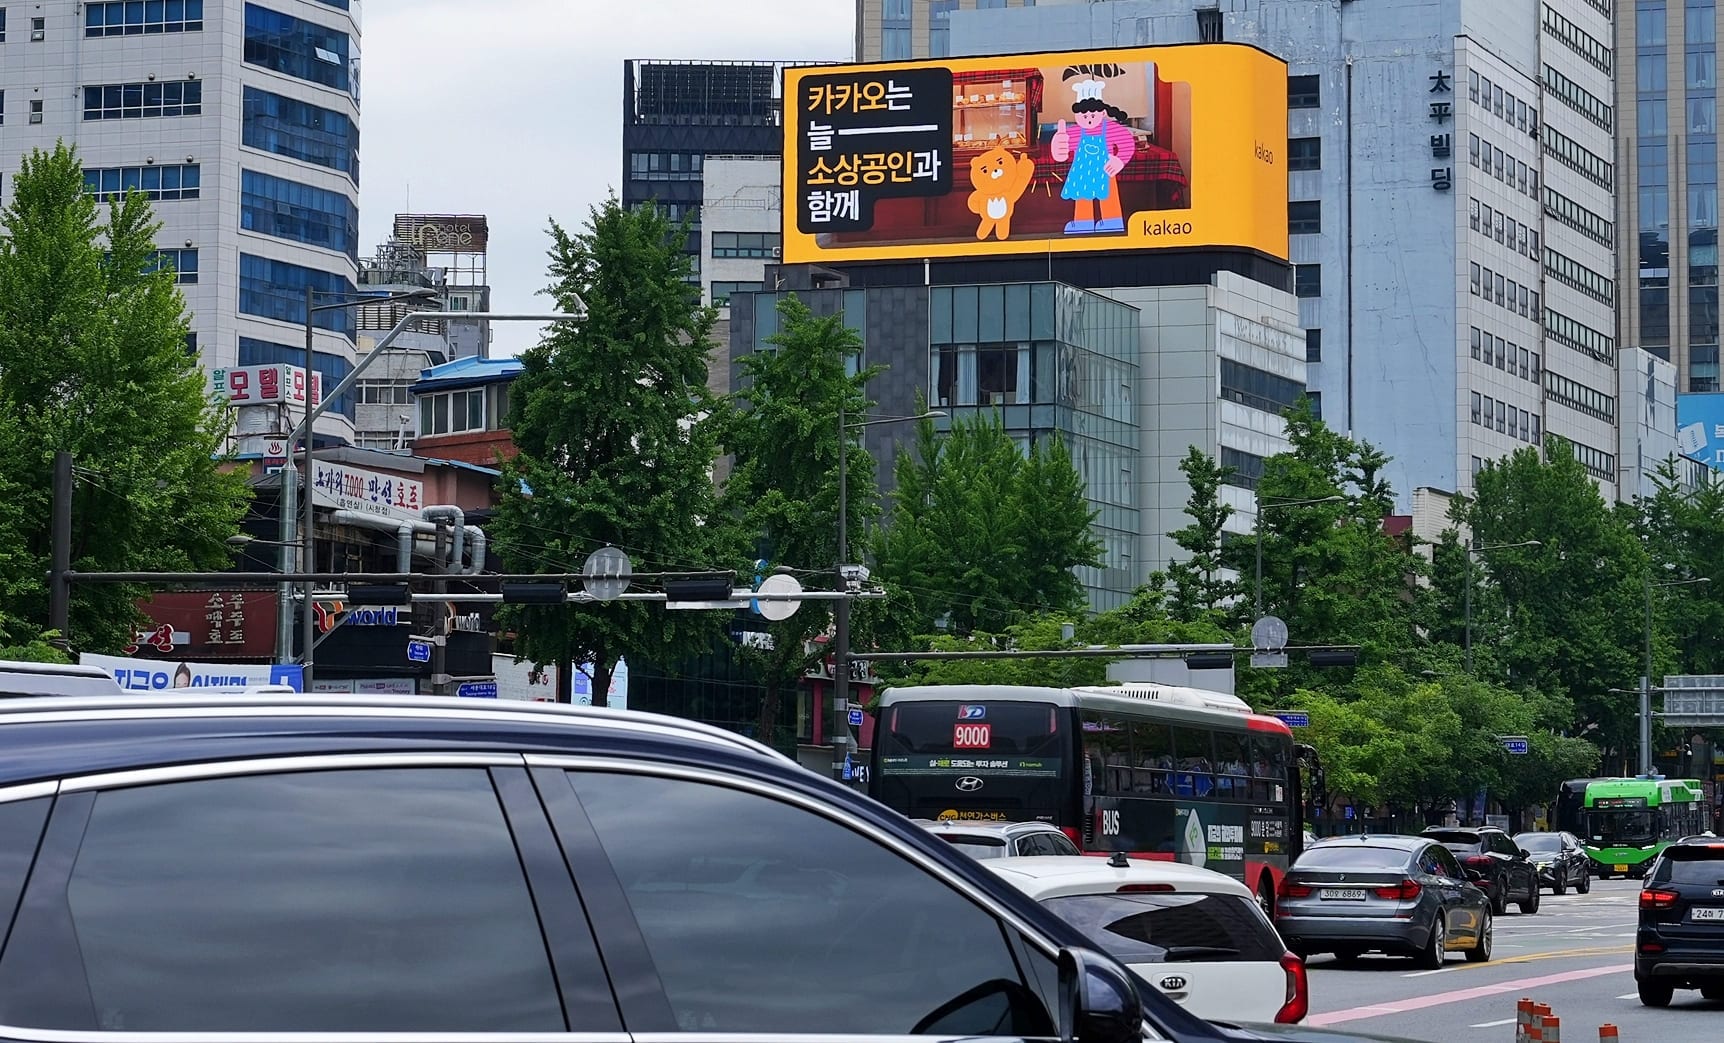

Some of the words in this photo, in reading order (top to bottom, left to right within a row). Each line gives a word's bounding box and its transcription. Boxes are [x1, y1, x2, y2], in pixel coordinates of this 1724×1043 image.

[807, 79, 913, 115] 카카오는
[807, 120, 835, 151] 늘
[1254, 139, 1274, 165] kakao
[806, 149, 942, 185] 소상공인과
[807, 189, 859, 222] 함께
[1143, 219, 1192, 236] kakao
[230, 367, 279, 400] 모텔
[348, 606, 397, 626] world
[955, 726, 989, 746] 9000
[1103, 810, 1120, 836] BUS
[1164, 978, 1183, 988] KIA
